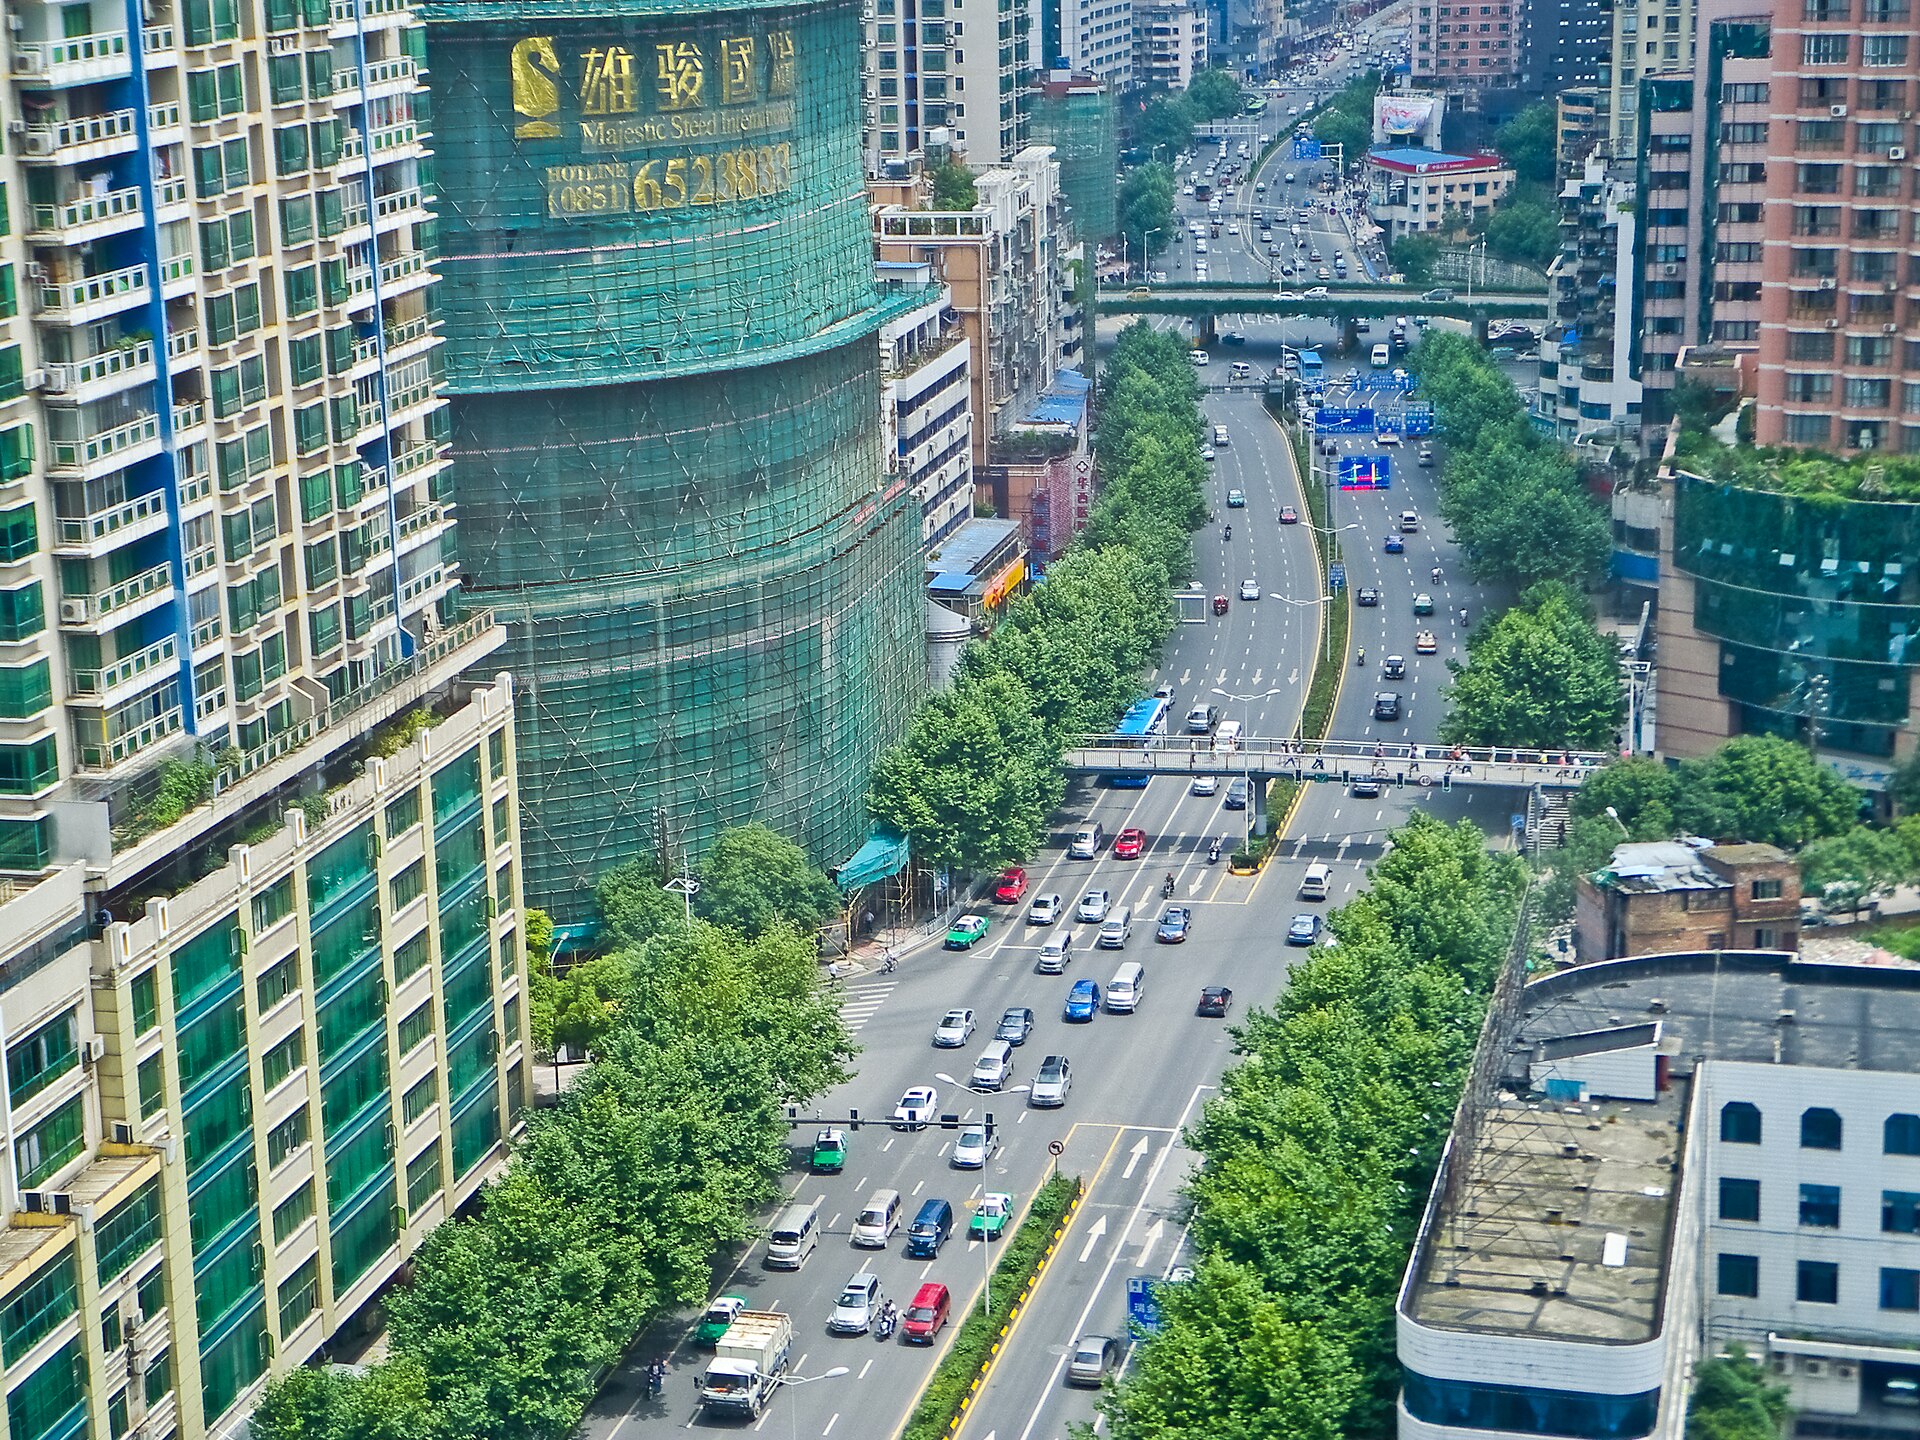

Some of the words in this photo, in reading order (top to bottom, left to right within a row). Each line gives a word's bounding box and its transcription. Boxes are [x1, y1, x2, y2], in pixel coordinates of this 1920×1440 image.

[579, 118, 666, 147] Majestic
[671, 114, 718, 139] Steed
[546, 163, 630, 182] HOTLINE
[547, 183, 629, 217] (0851)
